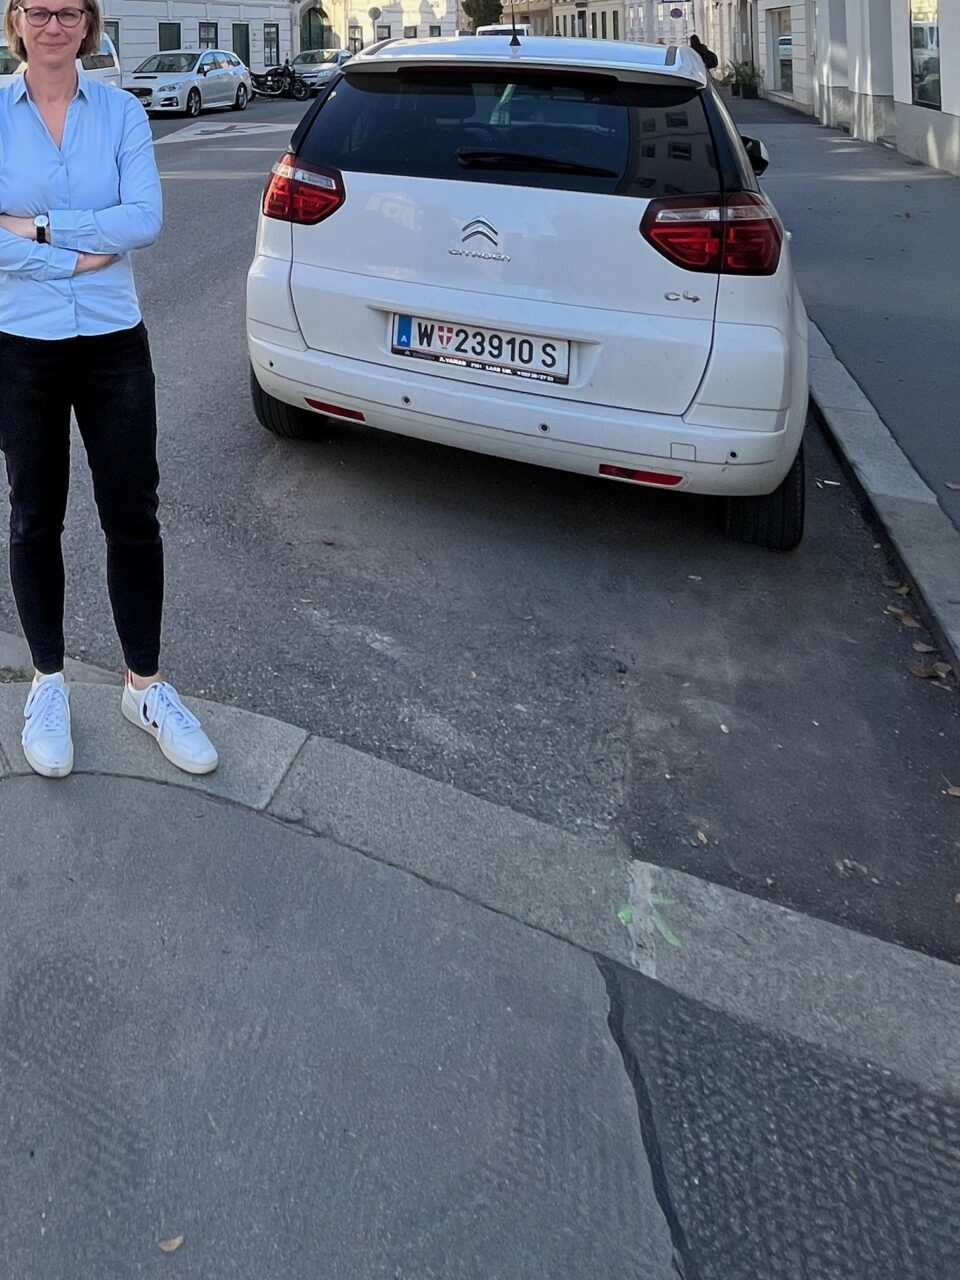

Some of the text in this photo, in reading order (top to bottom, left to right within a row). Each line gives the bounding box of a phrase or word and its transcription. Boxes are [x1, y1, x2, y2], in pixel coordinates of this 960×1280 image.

[664, 290, 700, 303] C4
[401, 335, 408, 343] A
[418, 322, 556, 368] W 23910 S
